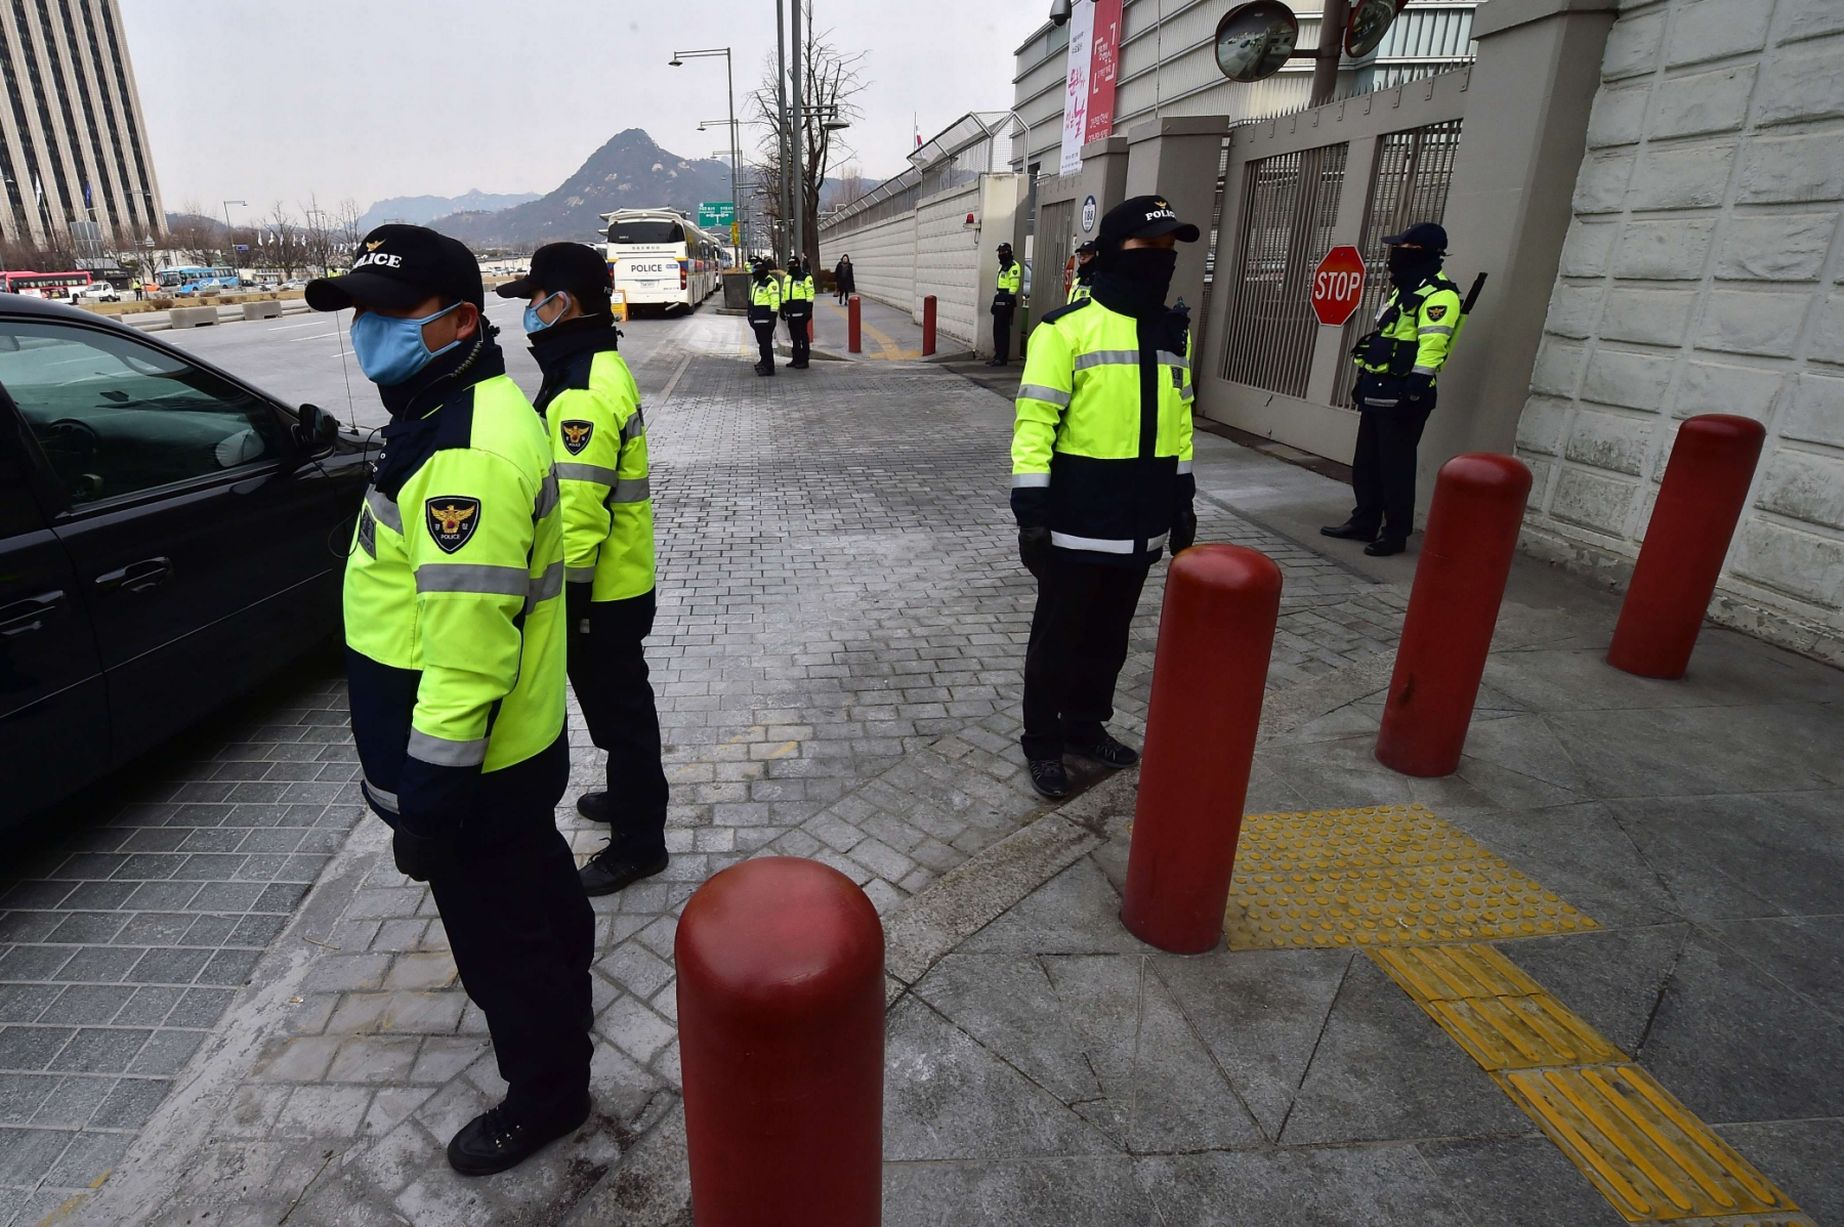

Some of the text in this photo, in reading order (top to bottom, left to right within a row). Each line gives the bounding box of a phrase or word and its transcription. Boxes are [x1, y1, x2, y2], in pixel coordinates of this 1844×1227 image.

[1145, 209, 1176, 221] POLIC
[631, 264, 662, 272] POLICE
[1315, 271, 1361, 301] STOP
